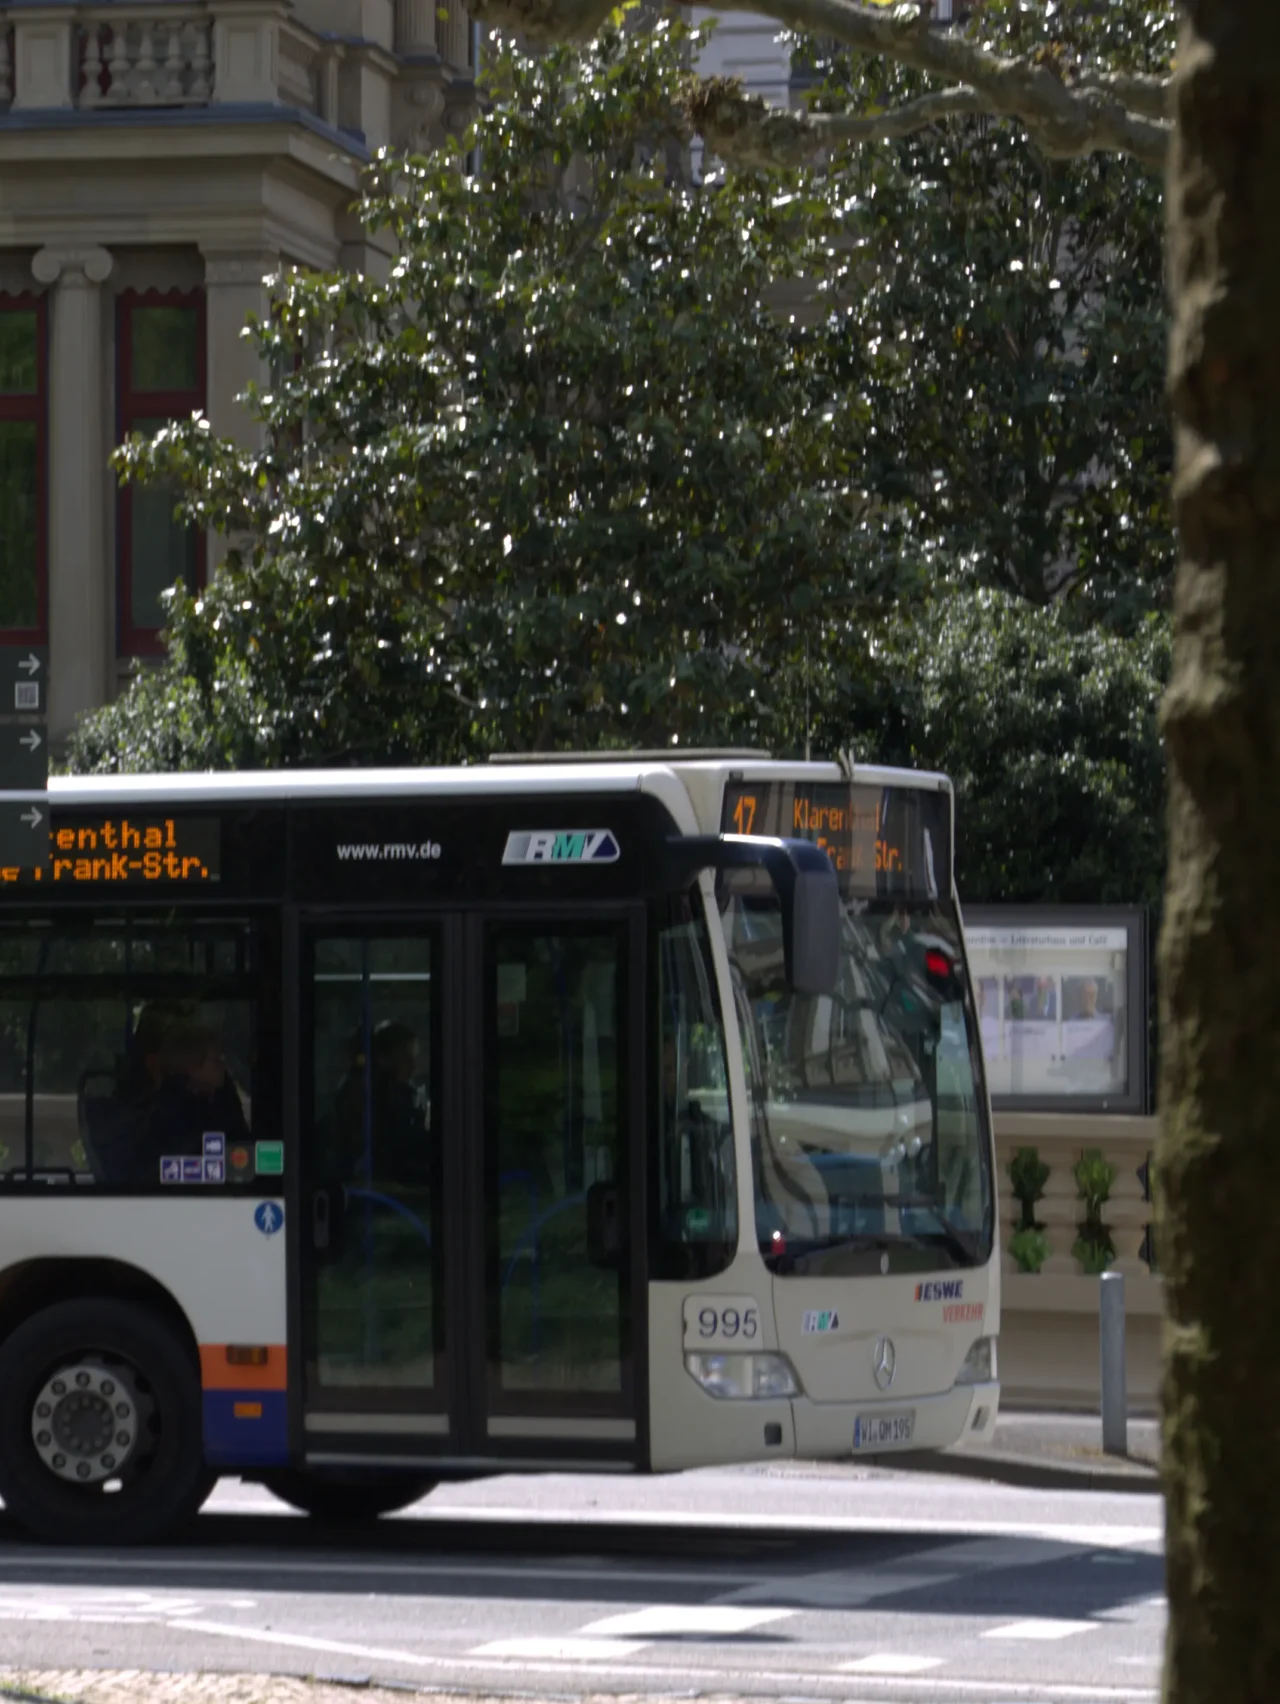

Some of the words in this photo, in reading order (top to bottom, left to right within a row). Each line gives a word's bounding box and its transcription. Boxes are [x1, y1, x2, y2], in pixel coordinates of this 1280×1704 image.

[733, 796, 756, 835] 17
[337, 841, 442, 860] www.rmv.de
[524, 832, 608, 861] RMV
[921, 1280, 963, 1301] ESWE
[698, 1307, 757, 1339] 995
[943, 1303, 984, 1324] VERKEHR
